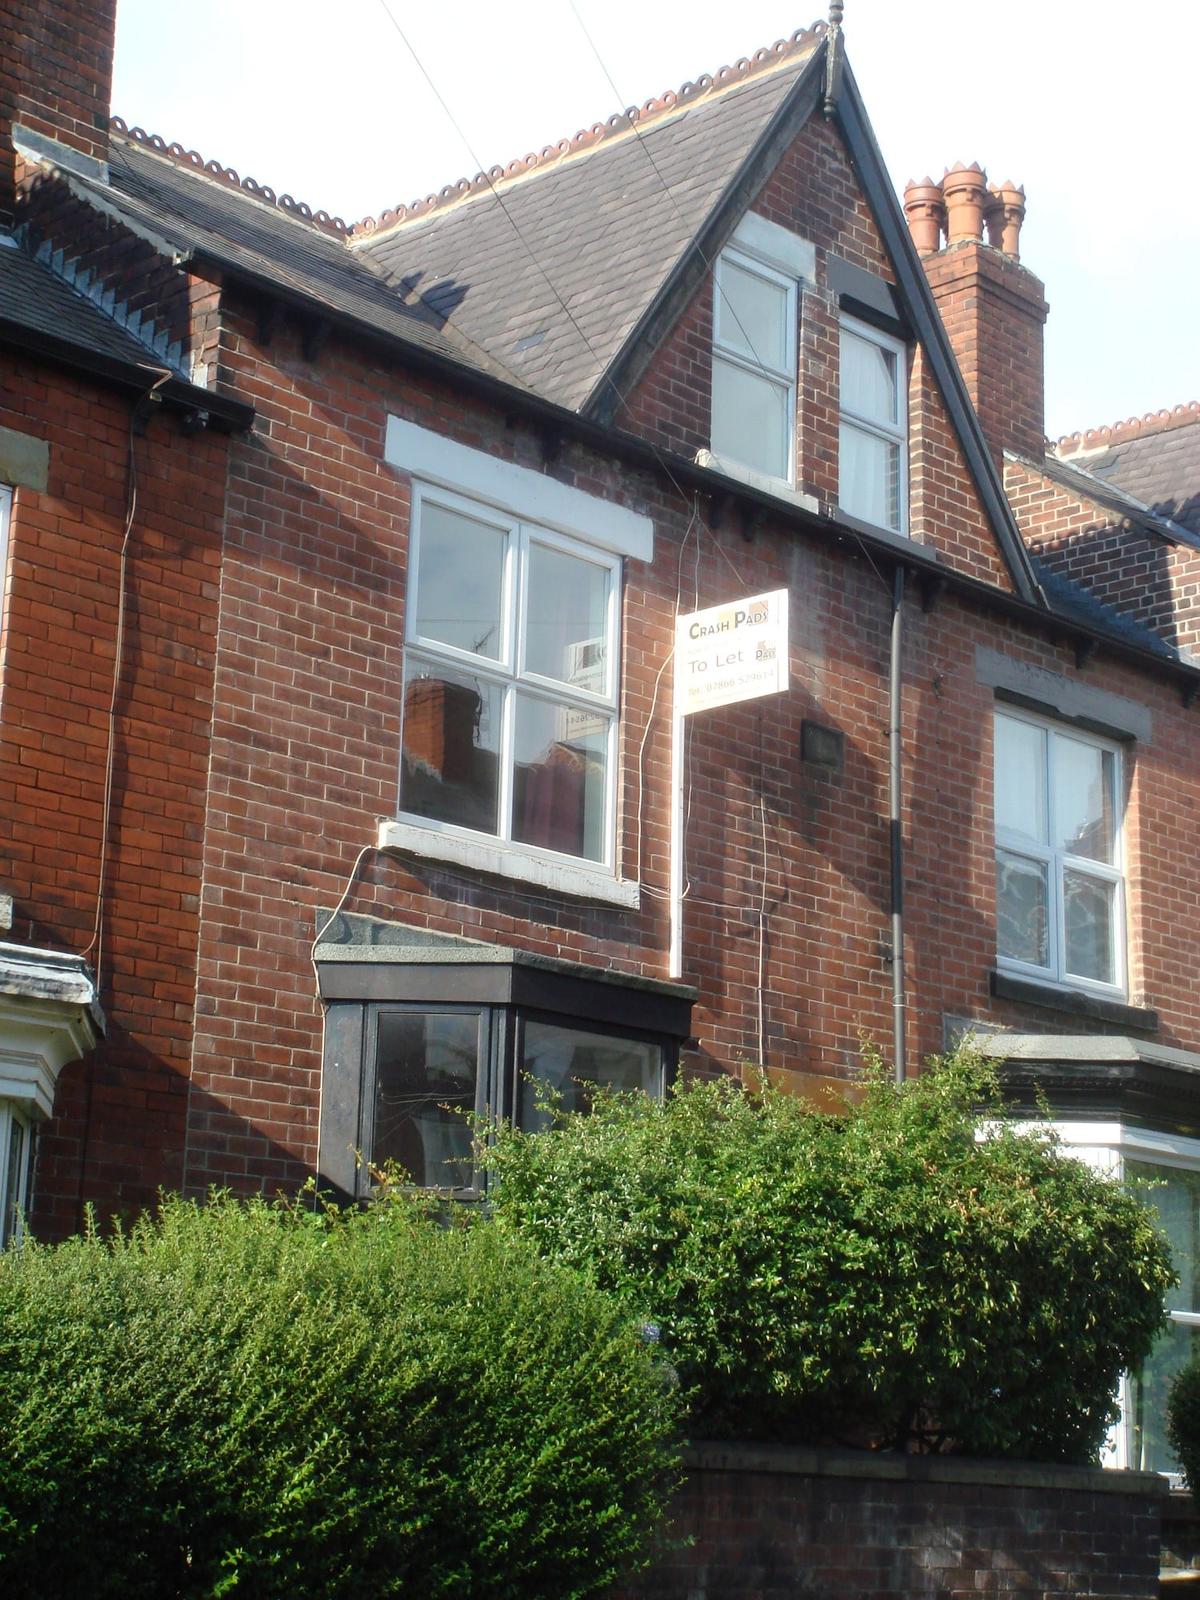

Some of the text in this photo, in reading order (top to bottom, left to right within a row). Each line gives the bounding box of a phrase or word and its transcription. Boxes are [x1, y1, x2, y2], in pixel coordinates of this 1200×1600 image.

[689, 610, 768, 640] CRASH PADS
[688, 650, 745, 674] To Let
